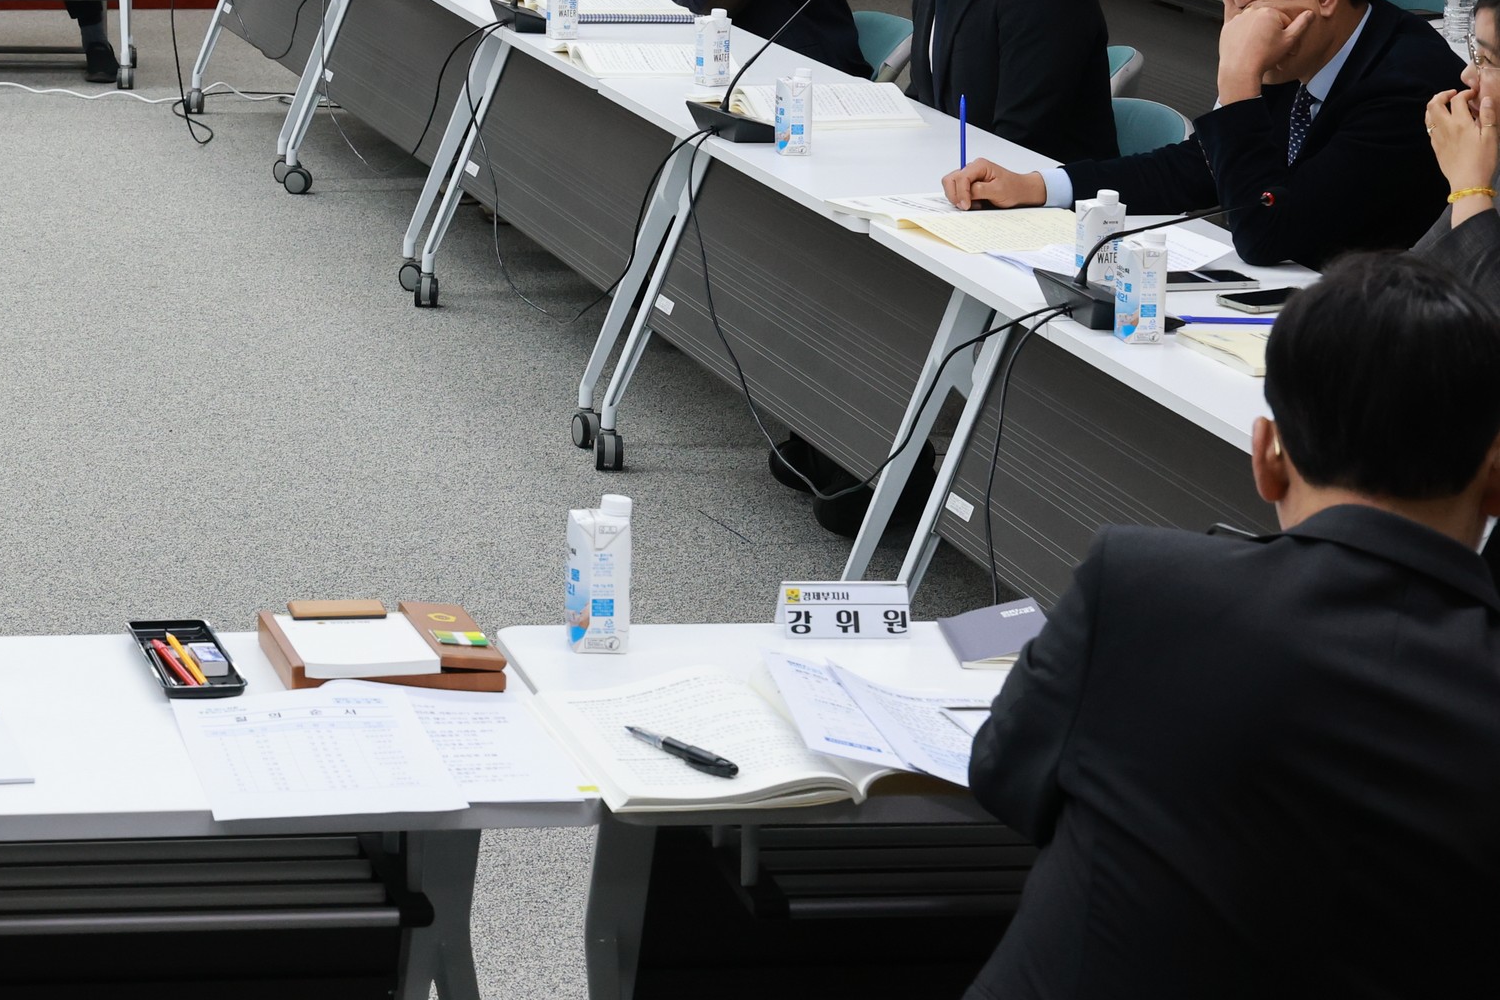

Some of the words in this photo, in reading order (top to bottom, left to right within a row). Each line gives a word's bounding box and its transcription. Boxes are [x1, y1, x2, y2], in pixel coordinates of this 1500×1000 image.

[558, 10, 577, 18] WATER
[1097, 252, 1118, 264] WATE
[787, 610, 812, 634] 강
[836, 609, 860, 634] 위
[883, 609, 908, 634] 원
